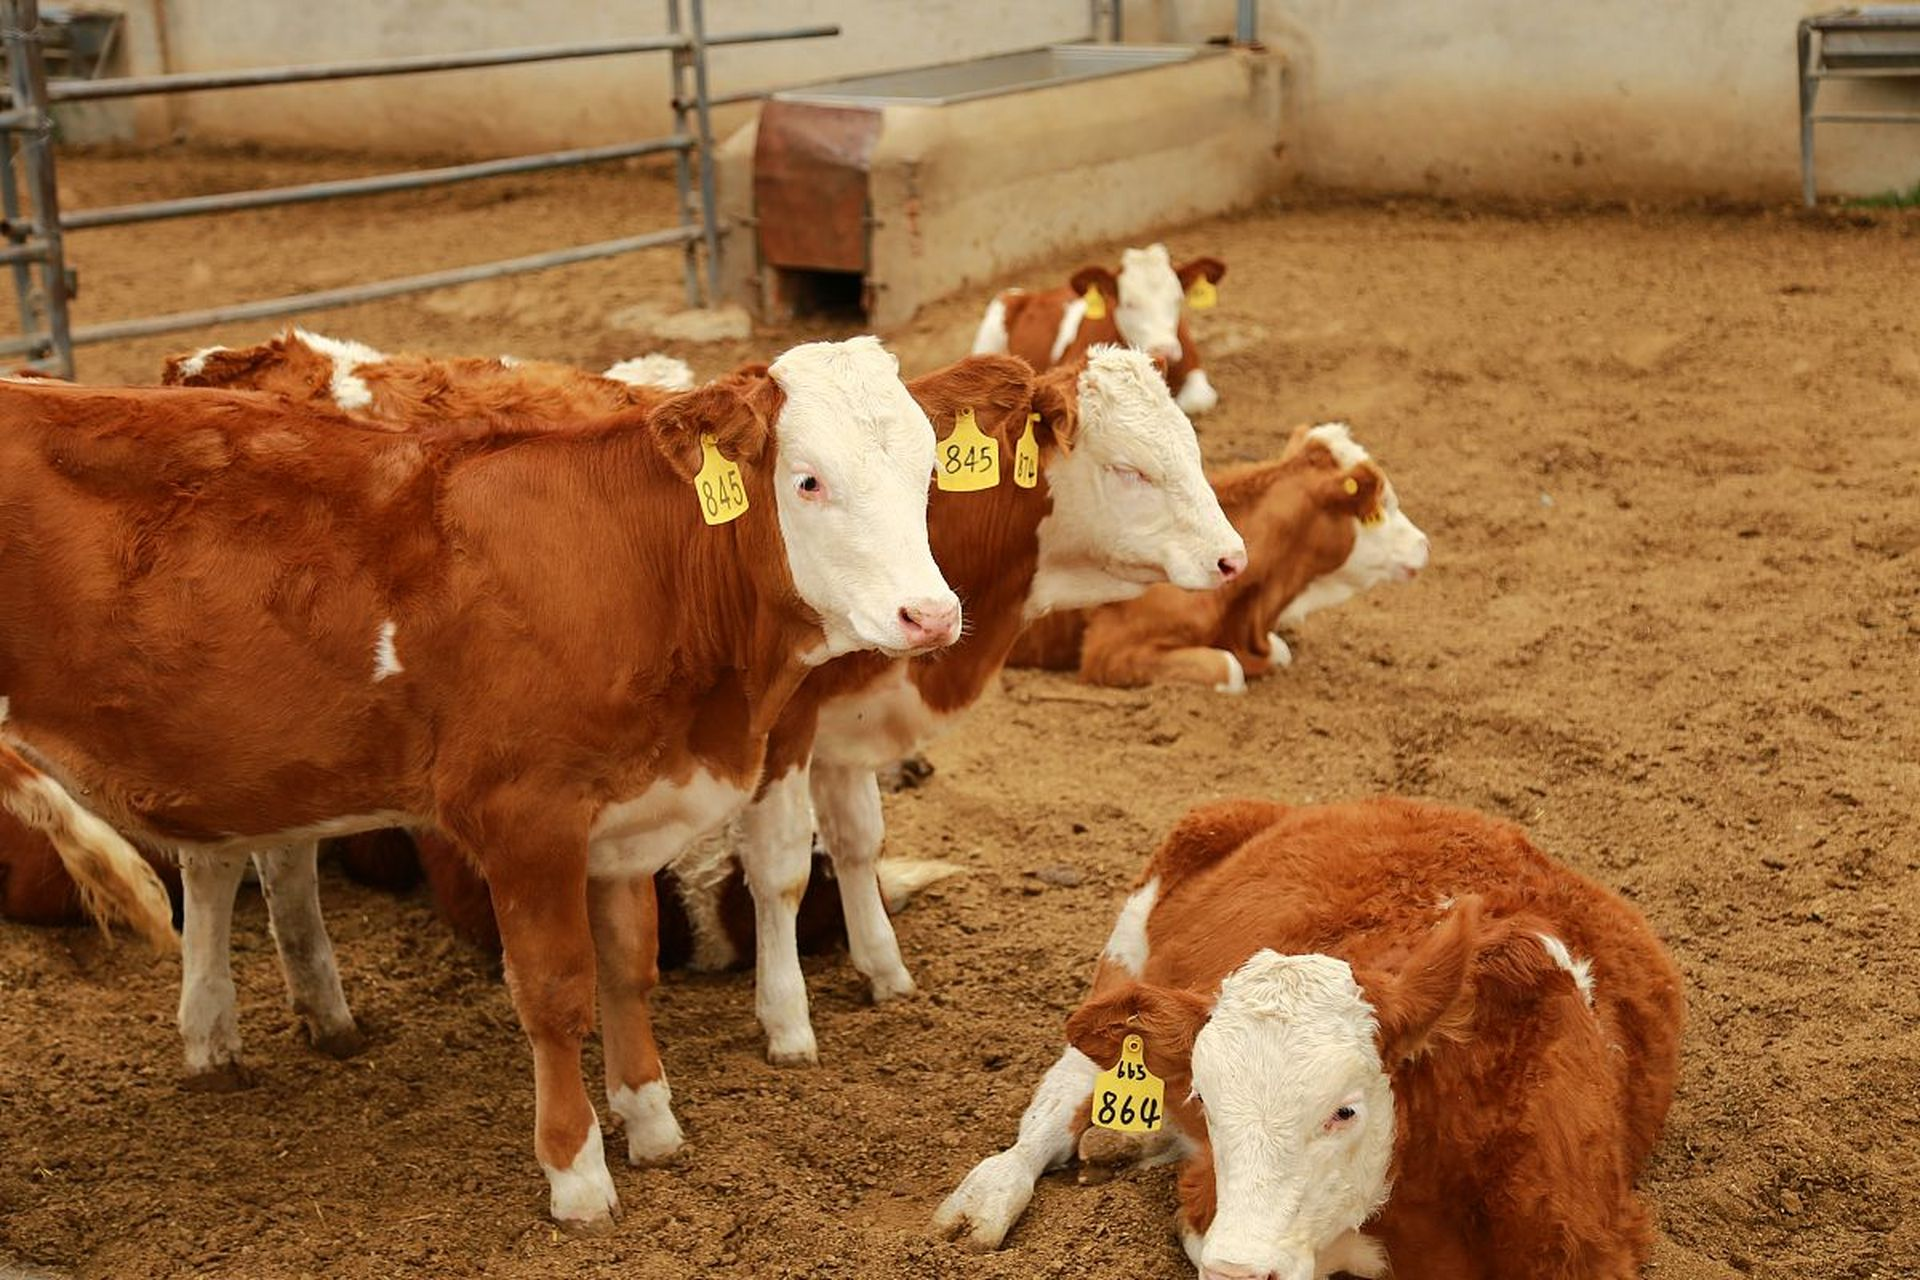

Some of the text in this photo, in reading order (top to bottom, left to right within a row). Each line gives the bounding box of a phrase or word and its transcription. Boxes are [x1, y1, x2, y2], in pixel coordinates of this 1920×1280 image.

[945, 444, 993, 475] 845
[702, 470, 744, 517] 845
[1098, 1091, 1161, 1129] 864
